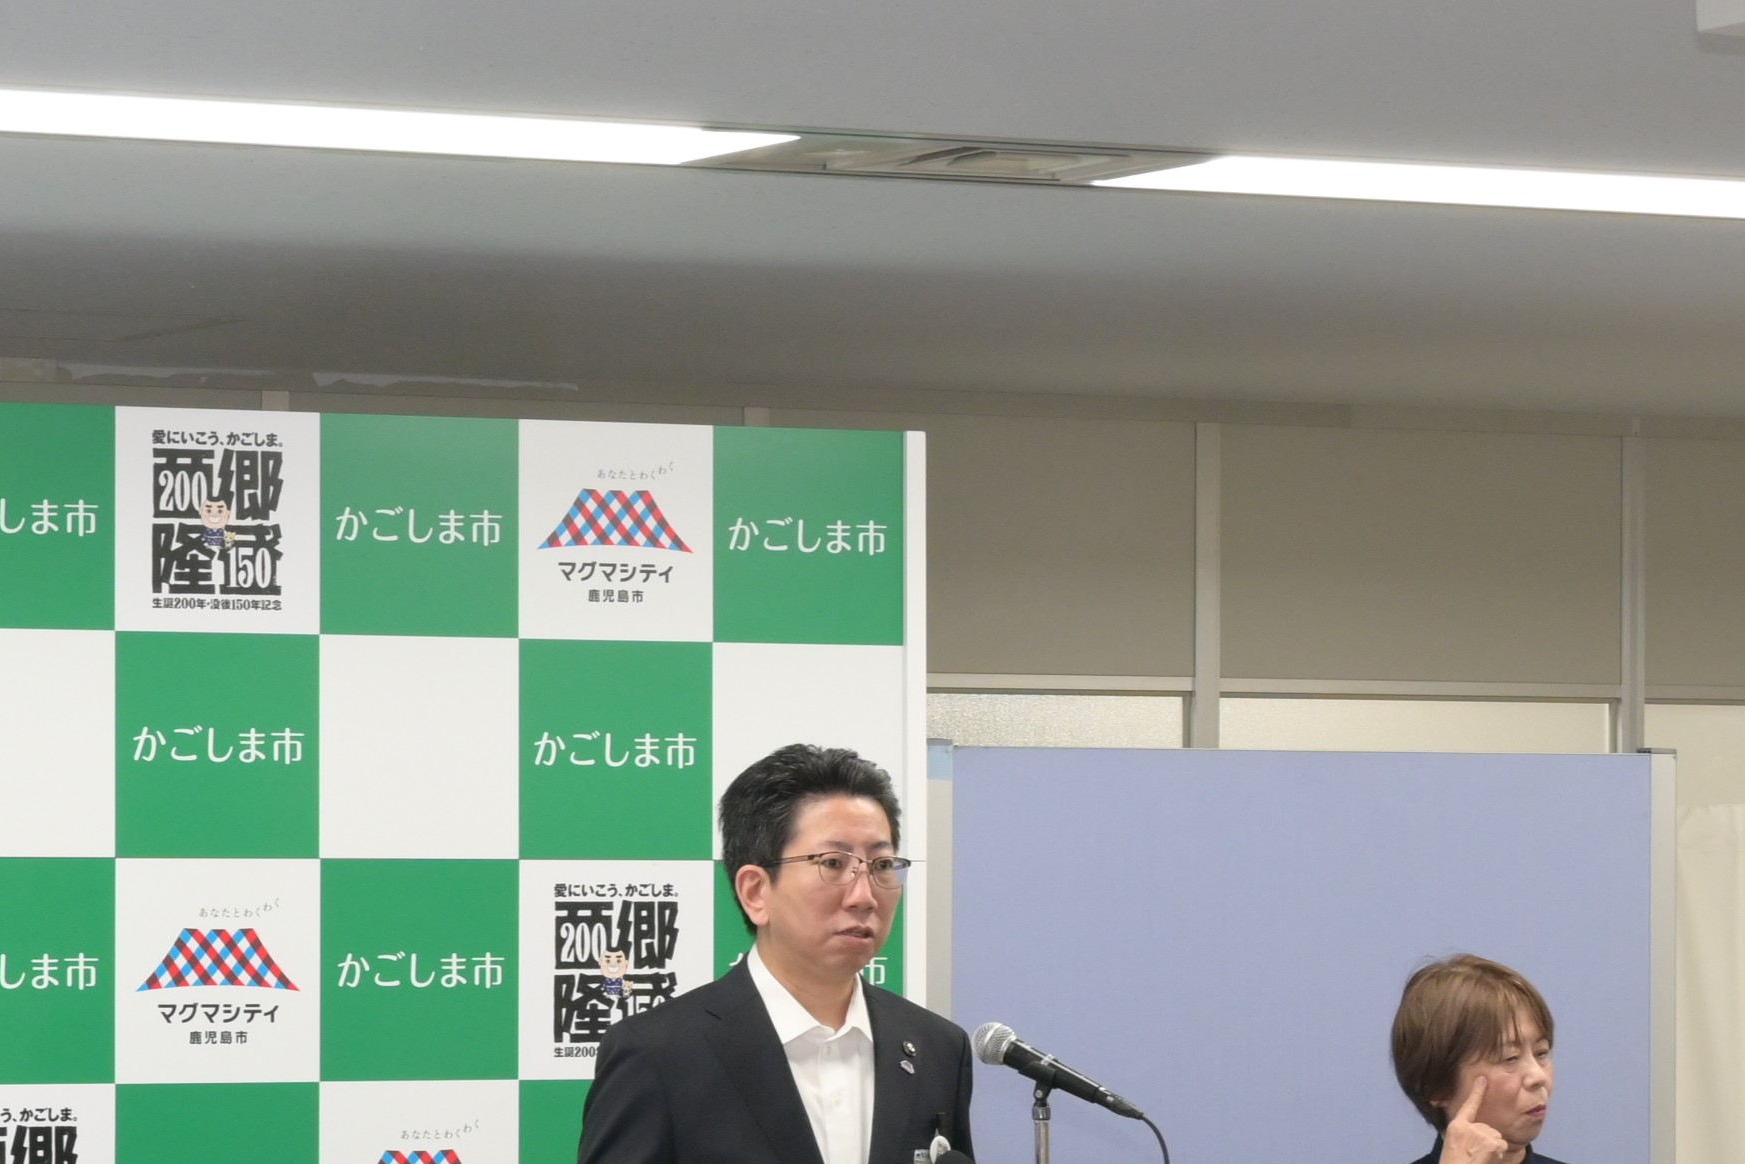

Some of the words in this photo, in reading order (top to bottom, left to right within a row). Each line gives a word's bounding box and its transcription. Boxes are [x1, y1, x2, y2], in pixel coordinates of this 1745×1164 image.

[152, 430, 282, 447] 愛にいこう、かごしま。
[597, 461, 675, 480] あなたとわくわく
[336, 506, 503, 546] かごしま市
[729, 517, 887, 556] かごしま市
[558, 561, 673, 583] マグマシティ
[588, 589, 643, 603] 鹿児島市
[133, 725, 305, 764] かごしま市
[534, 731, 697, 769] かごしま市
[554, 883, 678, 897] 愛にいこう、かごしま。
[197, 897, 281, 917] あなたとわくわく
[338, 951, 504, 989] かごしま市
[158, 1003, 278, 1023] マグマシティ
[190, 1031, 247, 1044] 鹿児島市
[399, 1119, 480, 1139] あなたとわくわく
